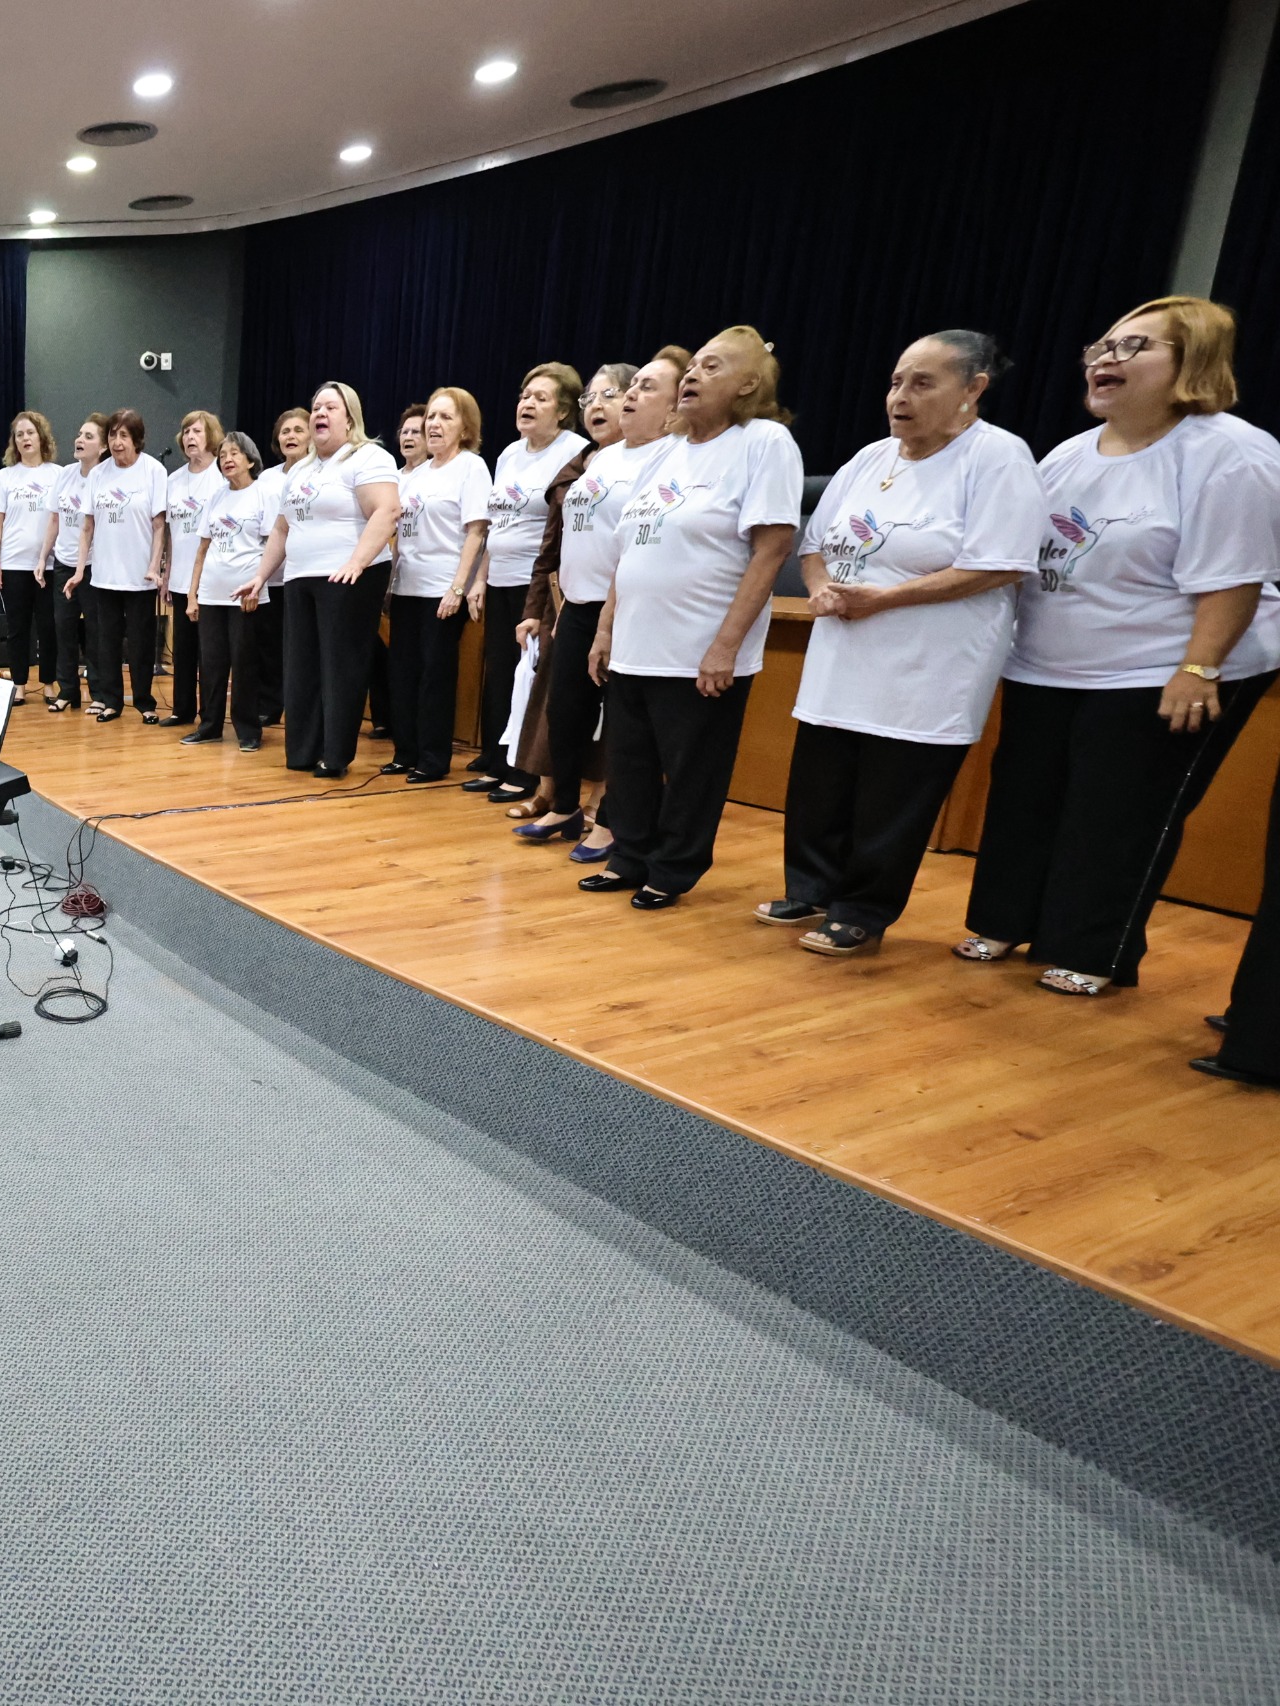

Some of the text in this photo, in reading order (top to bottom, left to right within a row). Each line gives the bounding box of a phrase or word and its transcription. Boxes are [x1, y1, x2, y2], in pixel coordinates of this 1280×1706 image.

[28, 501, 37, 512] 30
[295, 508, 304, 521] 30
[108, 512, 116, 523] 30
[573, 513, 584, 531] 30
[402, 523, 411, 537] 30
[635, 524, 650, 545] 30
[833, 562, 851, 584] 30
[1039, 569, 1059, 592] 30
